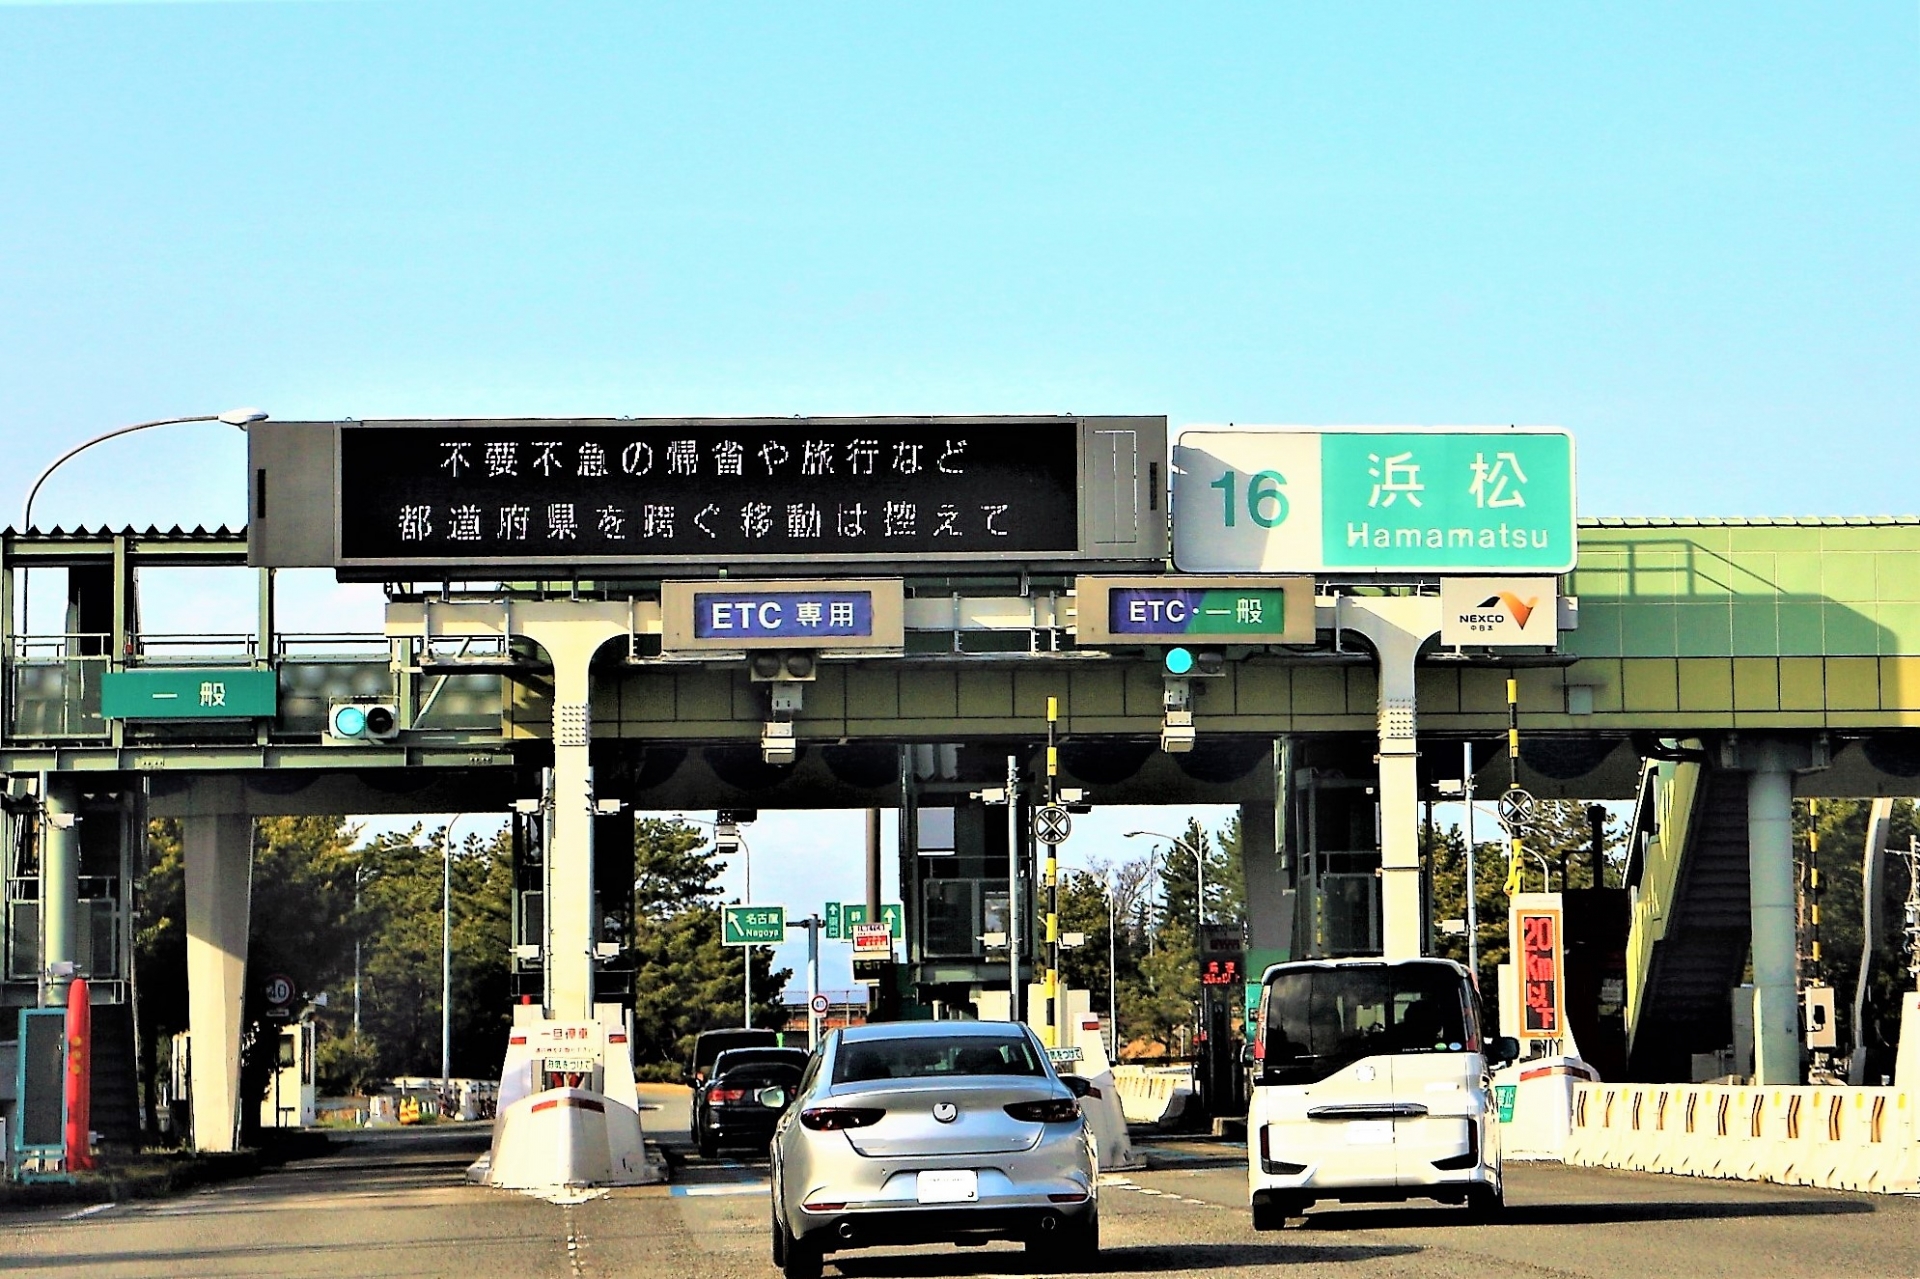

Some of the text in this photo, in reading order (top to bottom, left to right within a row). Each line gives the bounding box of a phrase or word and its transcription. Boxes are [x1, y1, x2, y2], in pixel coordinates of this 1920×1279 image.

[440, 439, 968, 478] 不要不急の帰省や旅行など
[1368, 451, 1529, 508] 浜松
[1210, 470, 1290, 528] 16
[398, 501, 1008, 541] 都道府県を跨ぐ移動は控えて
[1347, 522, 1549, 549] Hamamatsu
[712, 602, 854, 629] ETC 専用
[1459, 614, 1504, 623] NEXCO
[1470, 624, 1494, 632] 中日本
[152, 681, 226, 707] 一般
[745, 913, 780, 926] 名古屋
[746, 929, 780, 938] Nagoya
